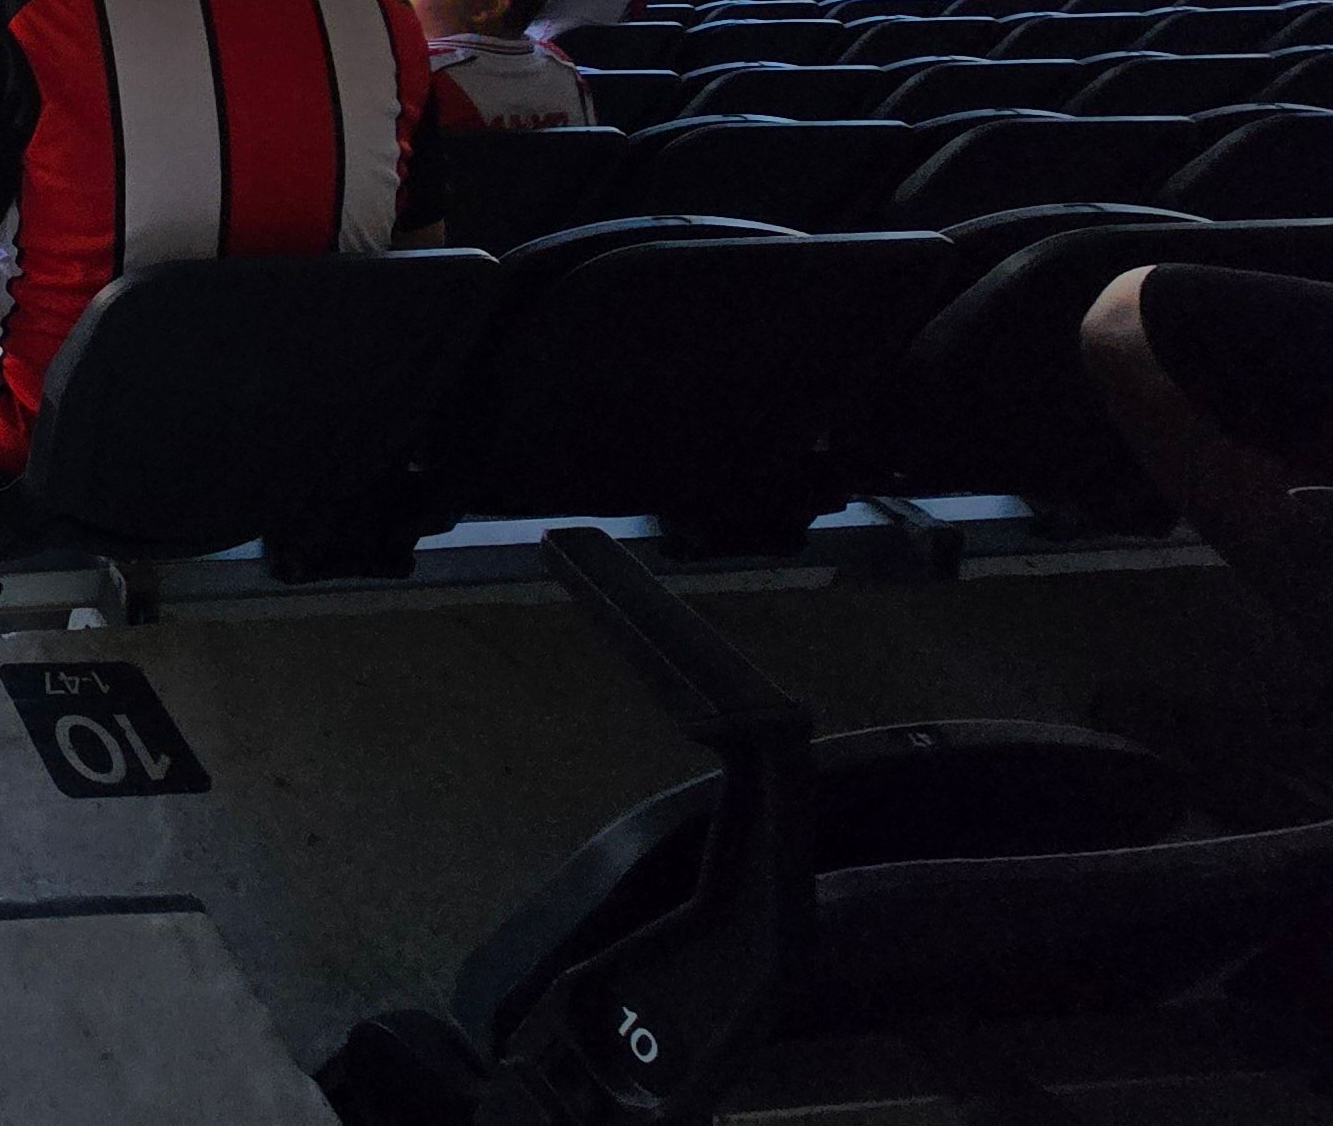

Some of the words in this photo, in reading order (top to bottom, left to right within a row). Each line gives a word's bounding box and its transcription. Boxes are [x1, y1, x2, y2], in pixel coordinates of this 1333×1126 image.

[44, 670, 111, 695] 1-47
[55, 713, 172, 785] 10
[617, 1005, 659, 1064] 10
